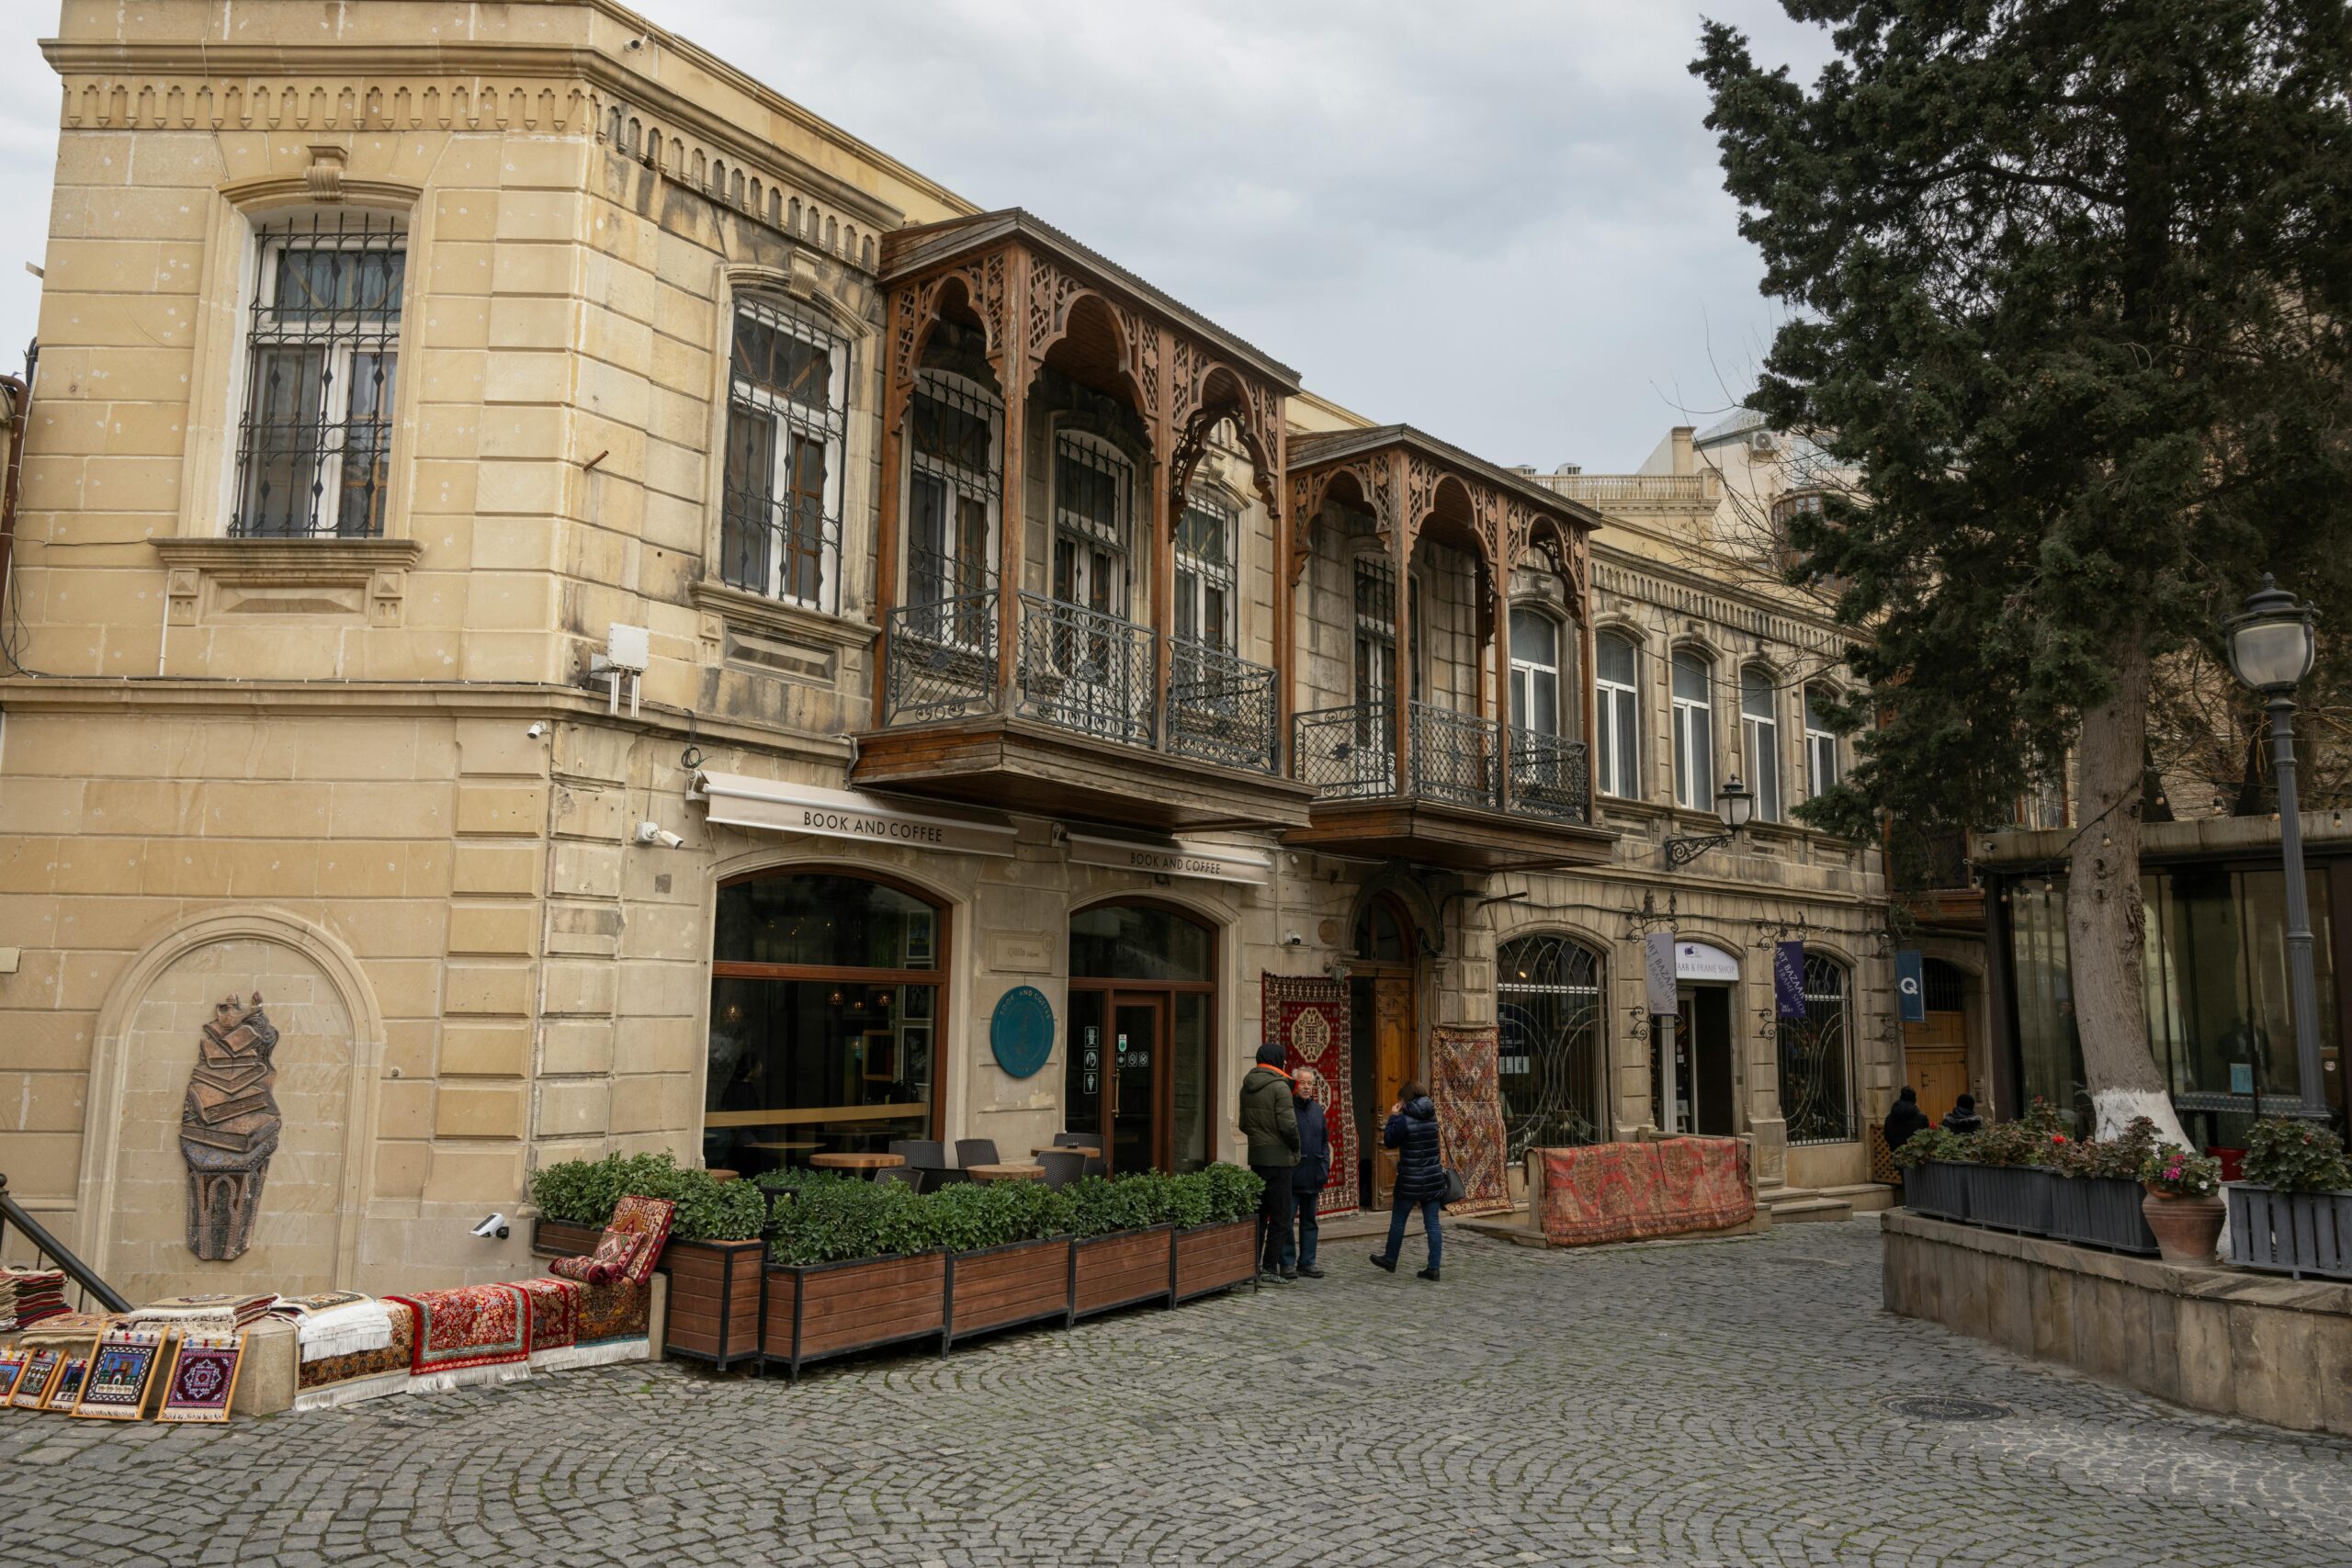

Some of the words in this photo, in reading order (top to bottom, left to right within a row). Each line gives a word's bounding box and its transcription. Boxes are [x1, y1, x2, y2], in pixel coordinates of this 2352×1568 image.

[804, 811, 848, 831] BOOK
[854, 818, 886, 835] AND
[889, 823, 943, 842] COFFEE
[1130, 852, 1159, 867] BOOK
[1162, 857, 1183, 870] AND
[1185, 860, 1221, 874] COFFEE
[1646, 939, 1659, 956] ART
[1776, 947, 1789, 963] ART
[1648, 963, 1666, 989] FRAME
[1690, 963, 1697, 972] &
[1697, 964, 1717, 974] FRAME
[1718, 964, 1736, 975] SHOP
[1779, 968, 1795, 993] FRAME
[1900, 976, 1918, 996] Q
[1019, 989, 1033, 998] AND
